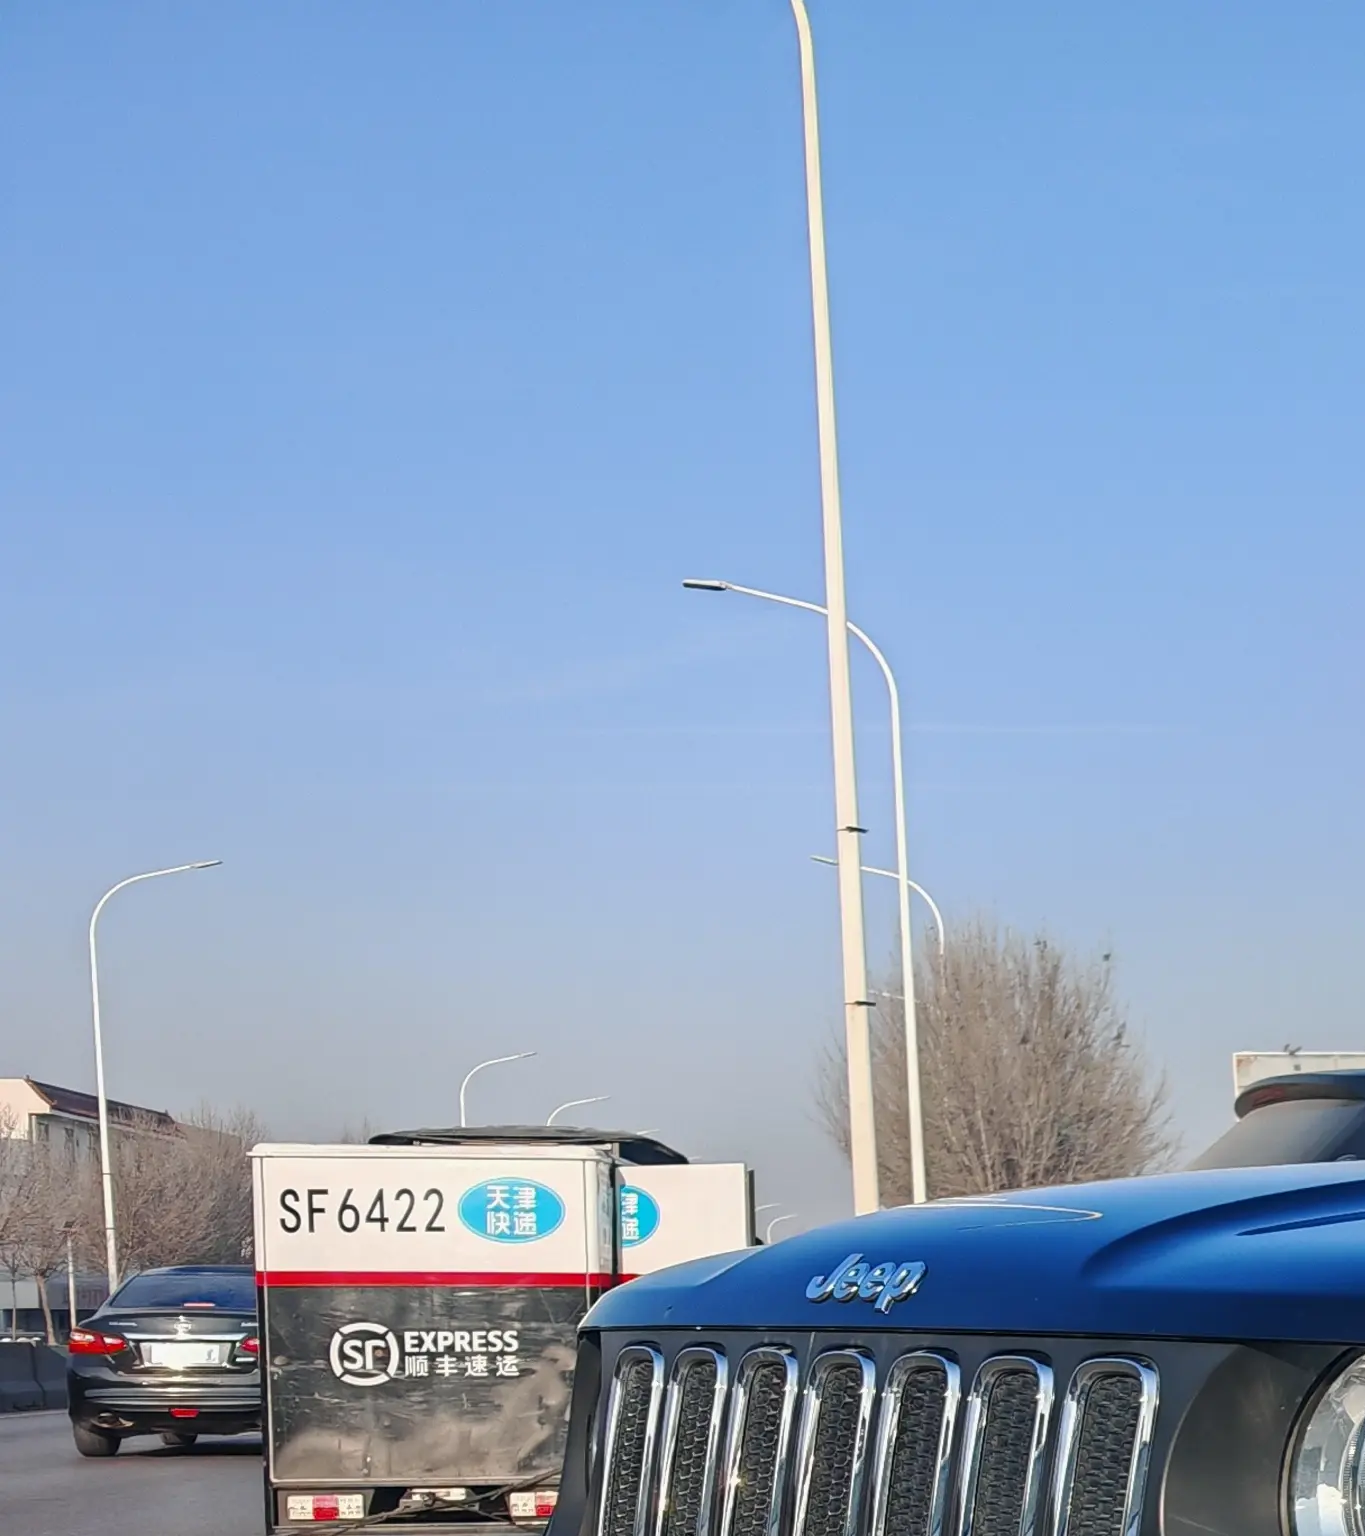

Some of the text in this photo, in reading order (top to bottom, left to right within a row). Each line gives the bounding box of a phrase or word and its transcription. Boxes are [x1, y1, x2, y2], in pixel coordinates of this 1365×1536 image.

[278, 1187, 447, 1235] SF6422
[484, 1185, 538, 1209] 天津
[485, 1210, 538, 1238] 快递
[805, 1253, 927, 1315] Jeep
[342, 1330, 519, 1370] SF EXPRESS
[404, 1354, 520, 1377] 顺丰速运
